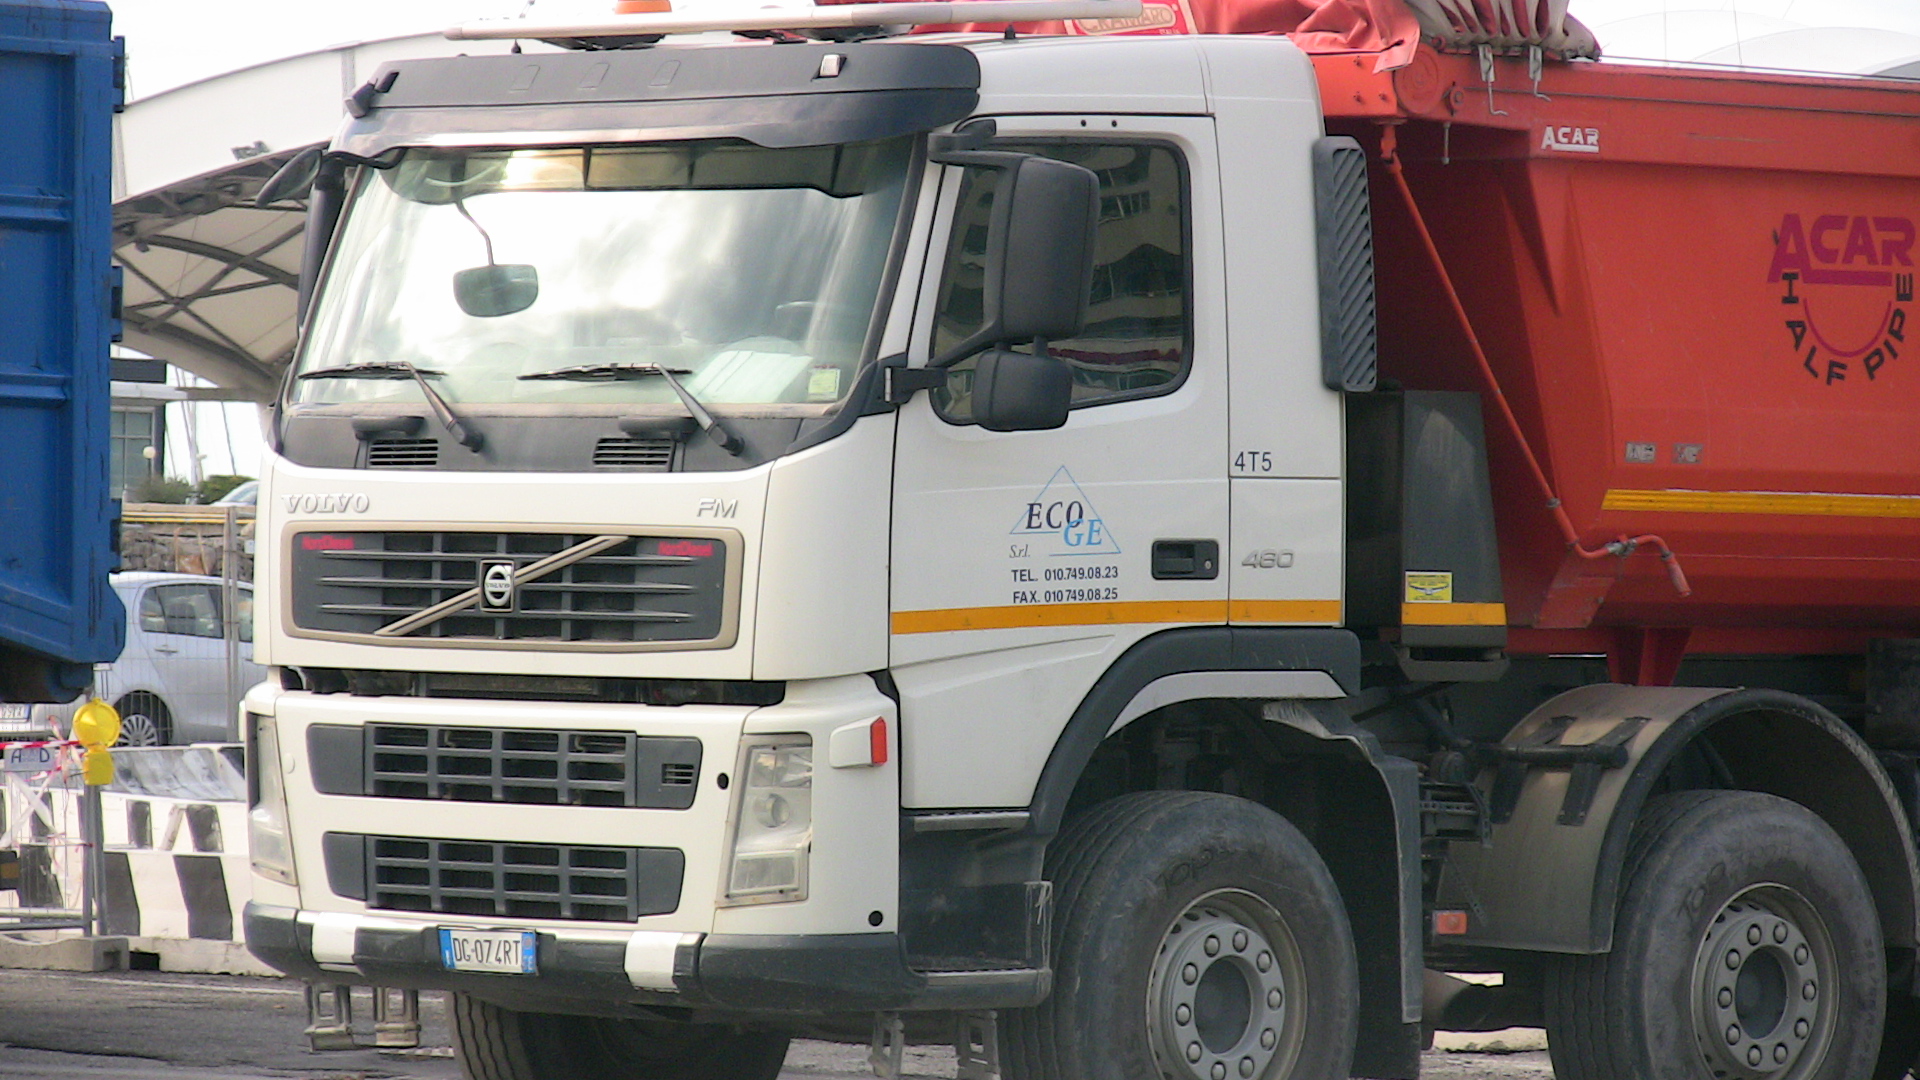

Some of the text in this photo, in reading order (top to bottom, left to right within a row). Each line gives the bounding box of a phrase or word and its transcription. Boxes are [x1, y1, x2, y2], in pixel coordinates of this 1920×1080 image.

[1541, 125, 1600, 153] ACAR
[1767, 213, 1916, 286] ACAR
[1234, 451, 1272, 472] 4T5
[281, 493, 370, 514] VOLVO
[696, 497, 738, 518] FM
[1025, 500, 1084, 529] ECO
[1064, 518, 1103, 547] GE
[1011, 566, 1119, 582] TEL. 010.749.08.23
[1013, 590, 1041, 604] FAX.
